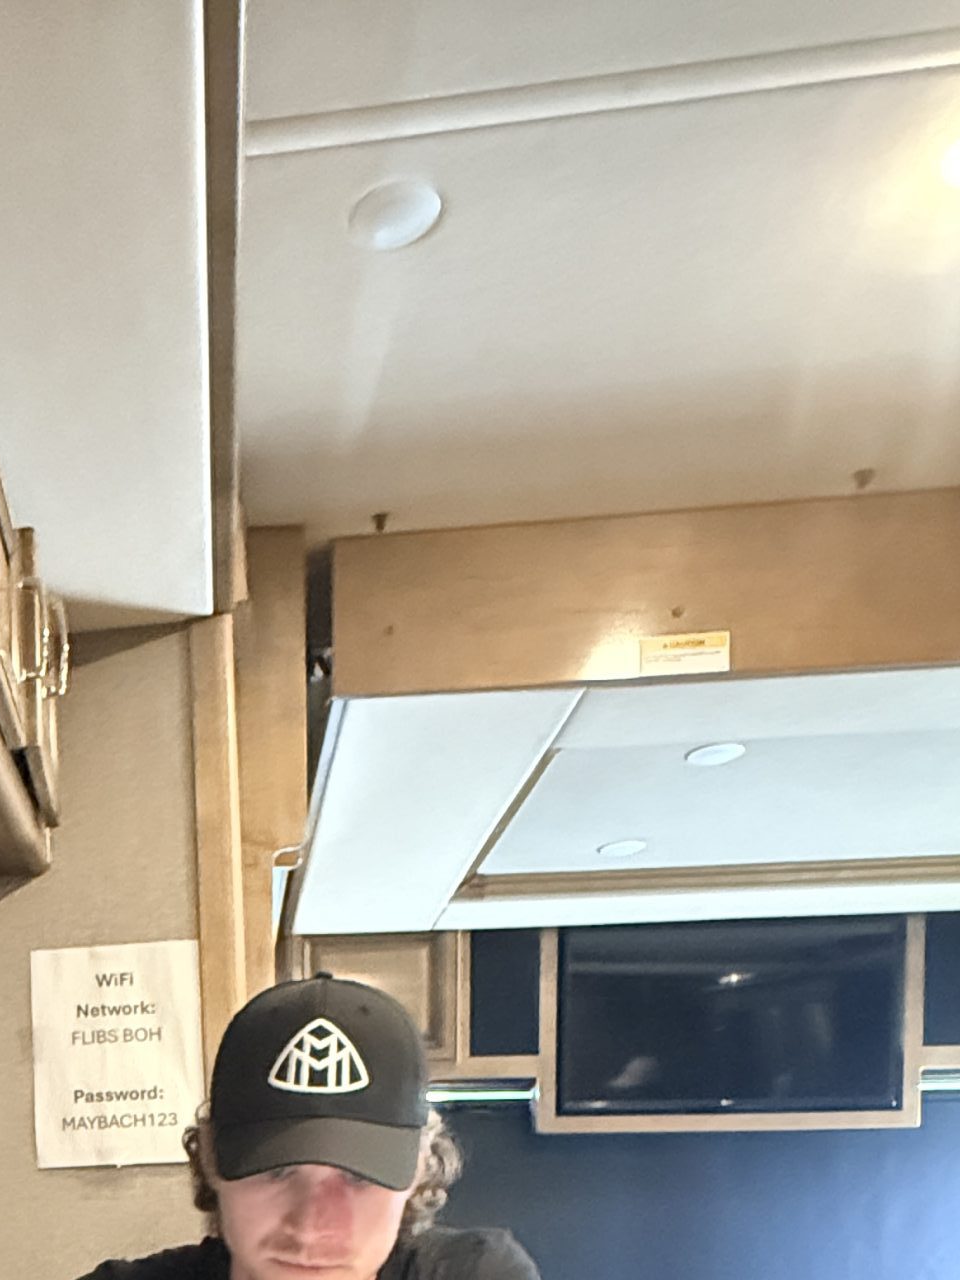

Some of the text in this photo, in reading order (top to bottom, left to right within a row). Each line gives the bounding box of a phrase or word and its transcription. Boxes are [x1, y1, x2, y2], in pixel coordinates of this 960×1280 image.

[95, 972, 134, 988] WiFi
[76, 1001, 156, 1018] Network:
[71, 1026, 162, 1045] FLIBS BOH
[73, 1085, 164, 1103] Password:
[61, 1112, 178, 1131] MAYBACH123
